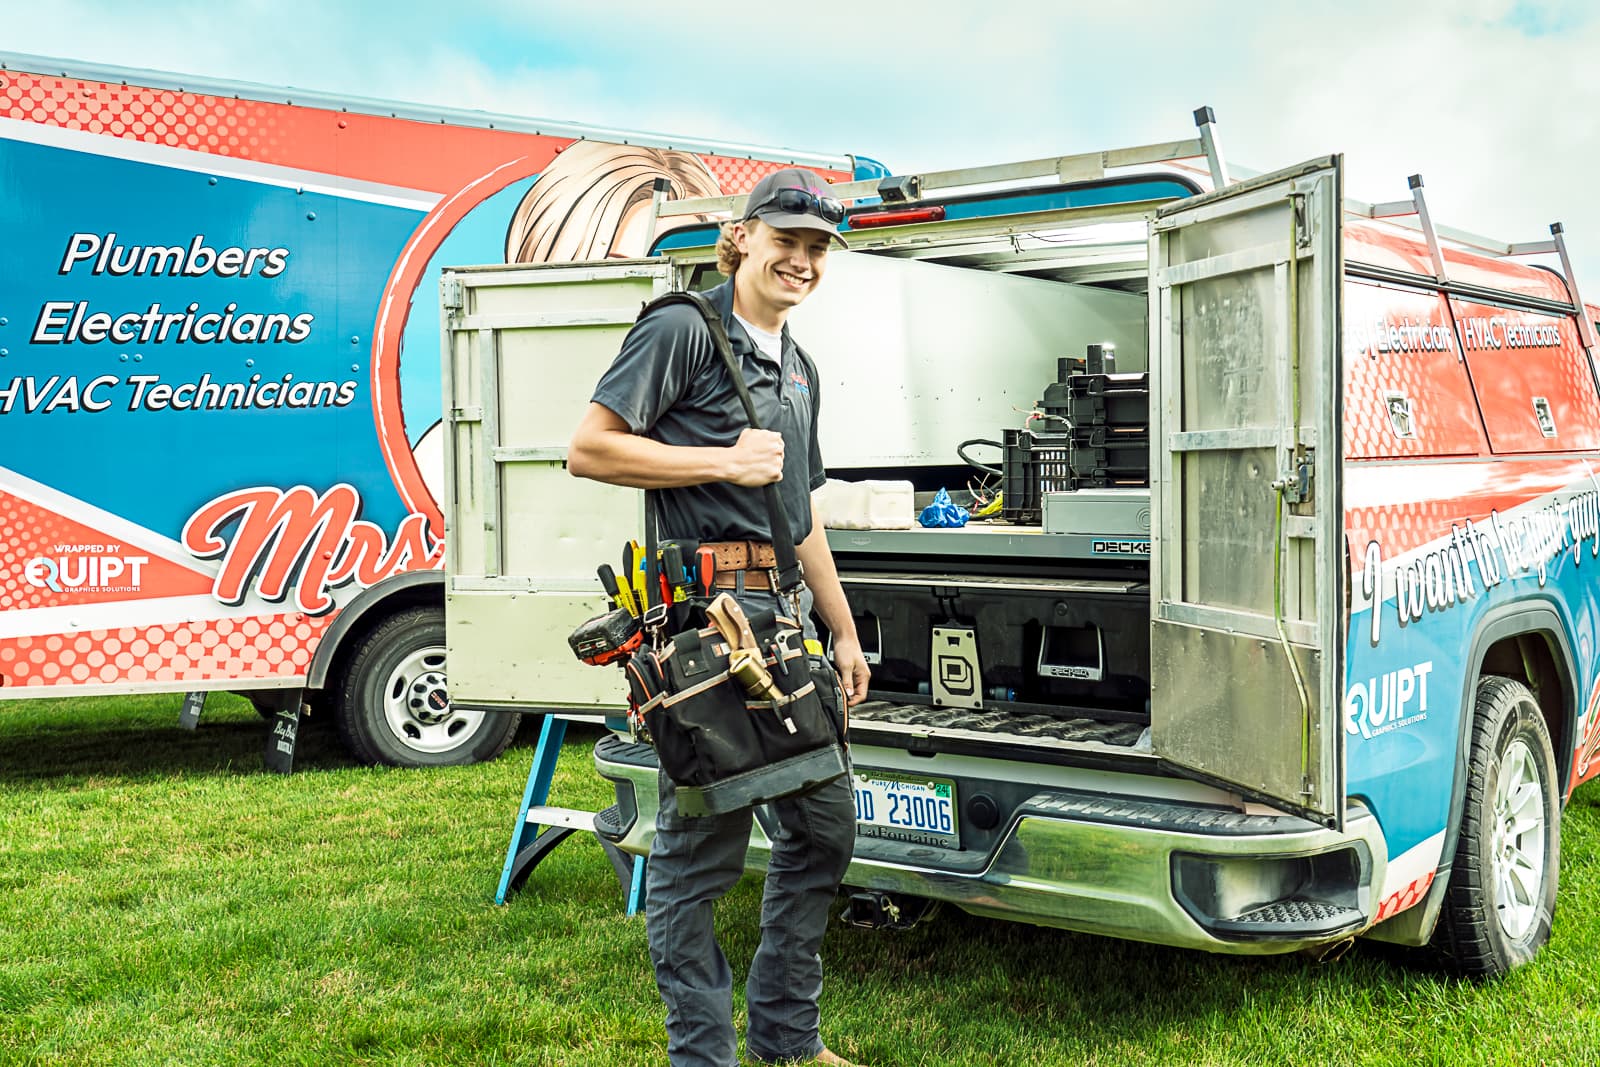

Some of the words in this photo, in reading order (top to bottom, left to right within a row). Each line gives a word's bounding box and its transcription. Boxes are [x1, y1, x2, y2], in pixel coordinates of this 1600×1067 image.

[58, 232, 289, 279] Plumbers
[30, 301, 315, 345] Electricians
[1465, 316, 1502, 352] HVAC
[1501, 316, 1561, 349] Technicians
[0, 374, 120, 415] HVAC
[126, 374, 358, 412] Technicians
[54, 544, 104, 553] WRAPPED
[107, 544, 121, 553] BY
[1362, 540, 1381, 649] I
[1395, 523, 1475, 629] want
[1466, 518, 1502, 593] to
[1491, 508, 1530, 577] be
[871, 780, 887, 788] PURE
[884, 780, 926, 793] MICHIGAN
[887, 793, 951, 832] 23006
[857, 825, 948, 847] LaFontaine
